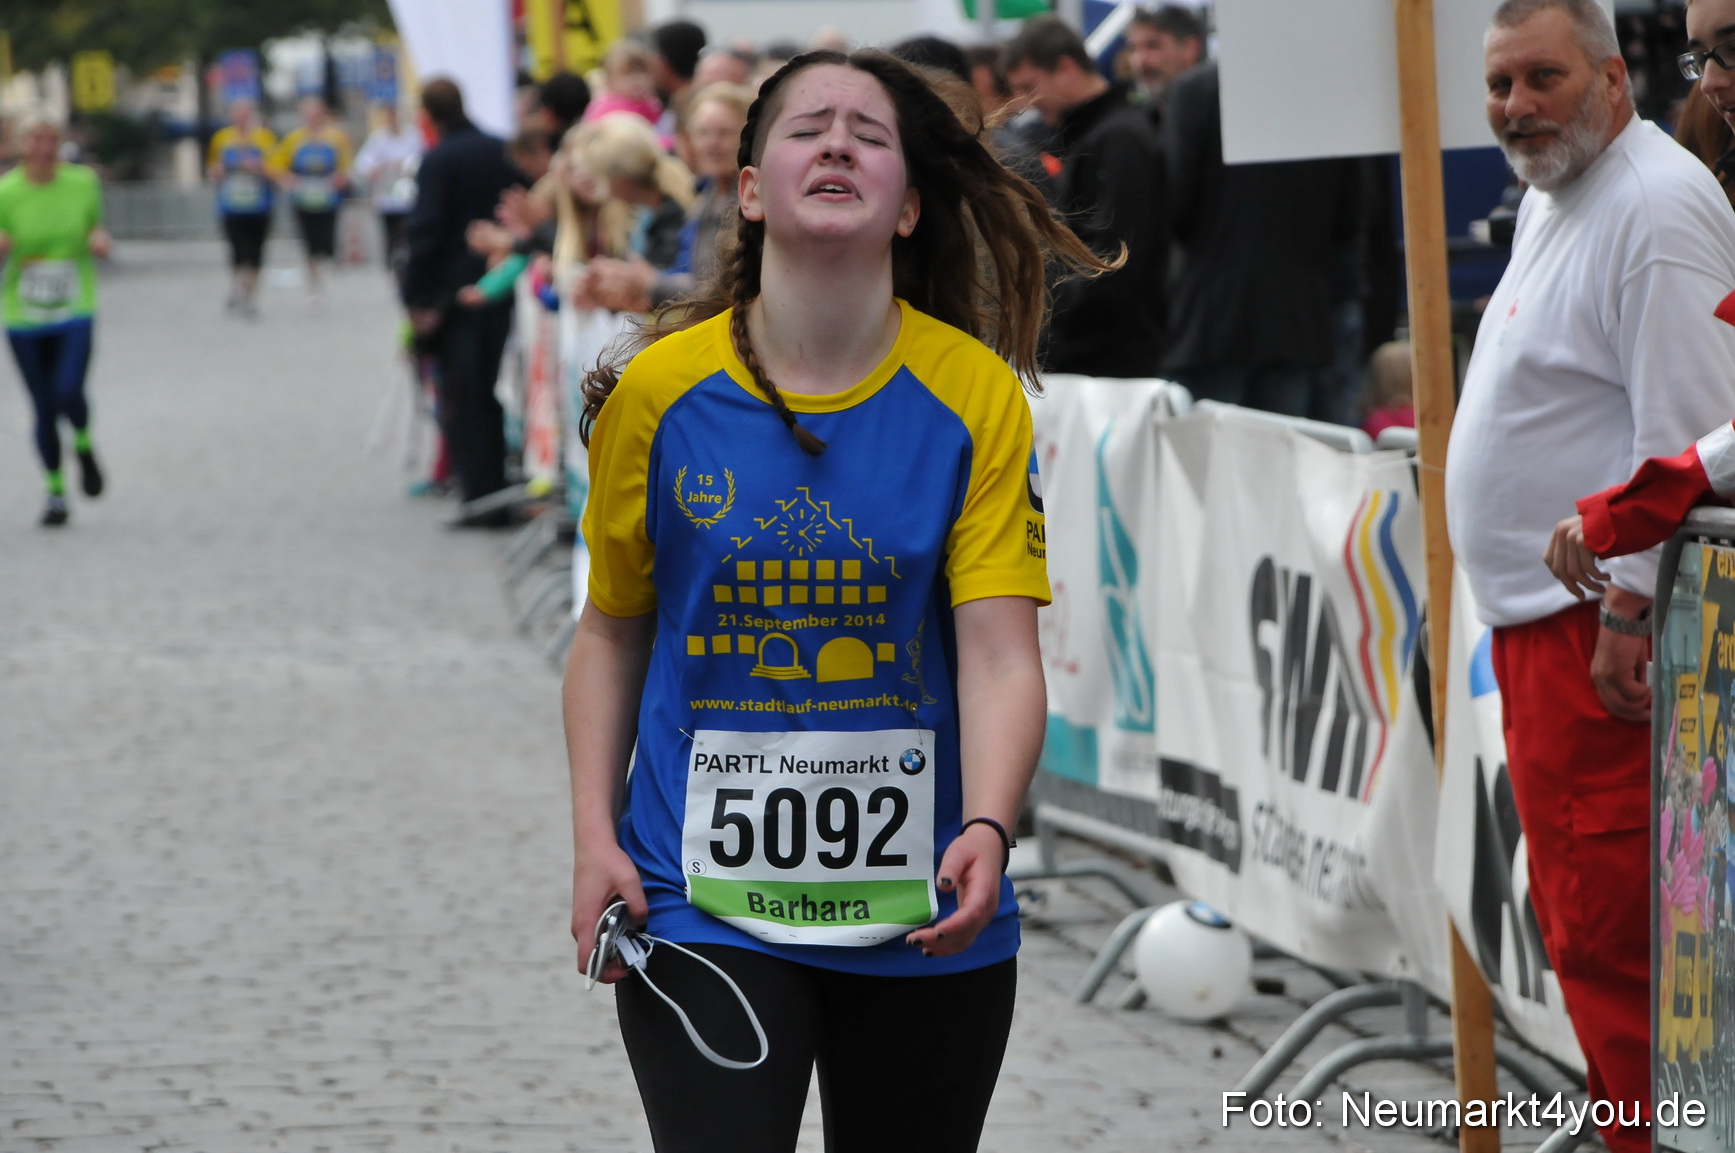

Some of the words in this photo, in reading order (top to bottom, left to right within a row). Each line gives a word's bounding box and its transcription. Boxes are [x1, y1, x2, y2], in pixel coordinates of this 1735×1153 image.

[697, 474, 714, 486] 15
[687, 491, 722, 504] Jahre
[1026, 520, 1045, 543] PA
[843, 613, 886, 627] 2014
[694, 753, 772, 774] PARTL
[779, 755, 889, 774] Neumarkt
[709, 787, 908, 869] 5092
[692, 861, 701, 873] S
[746, 892, 870, 922] Barbara
